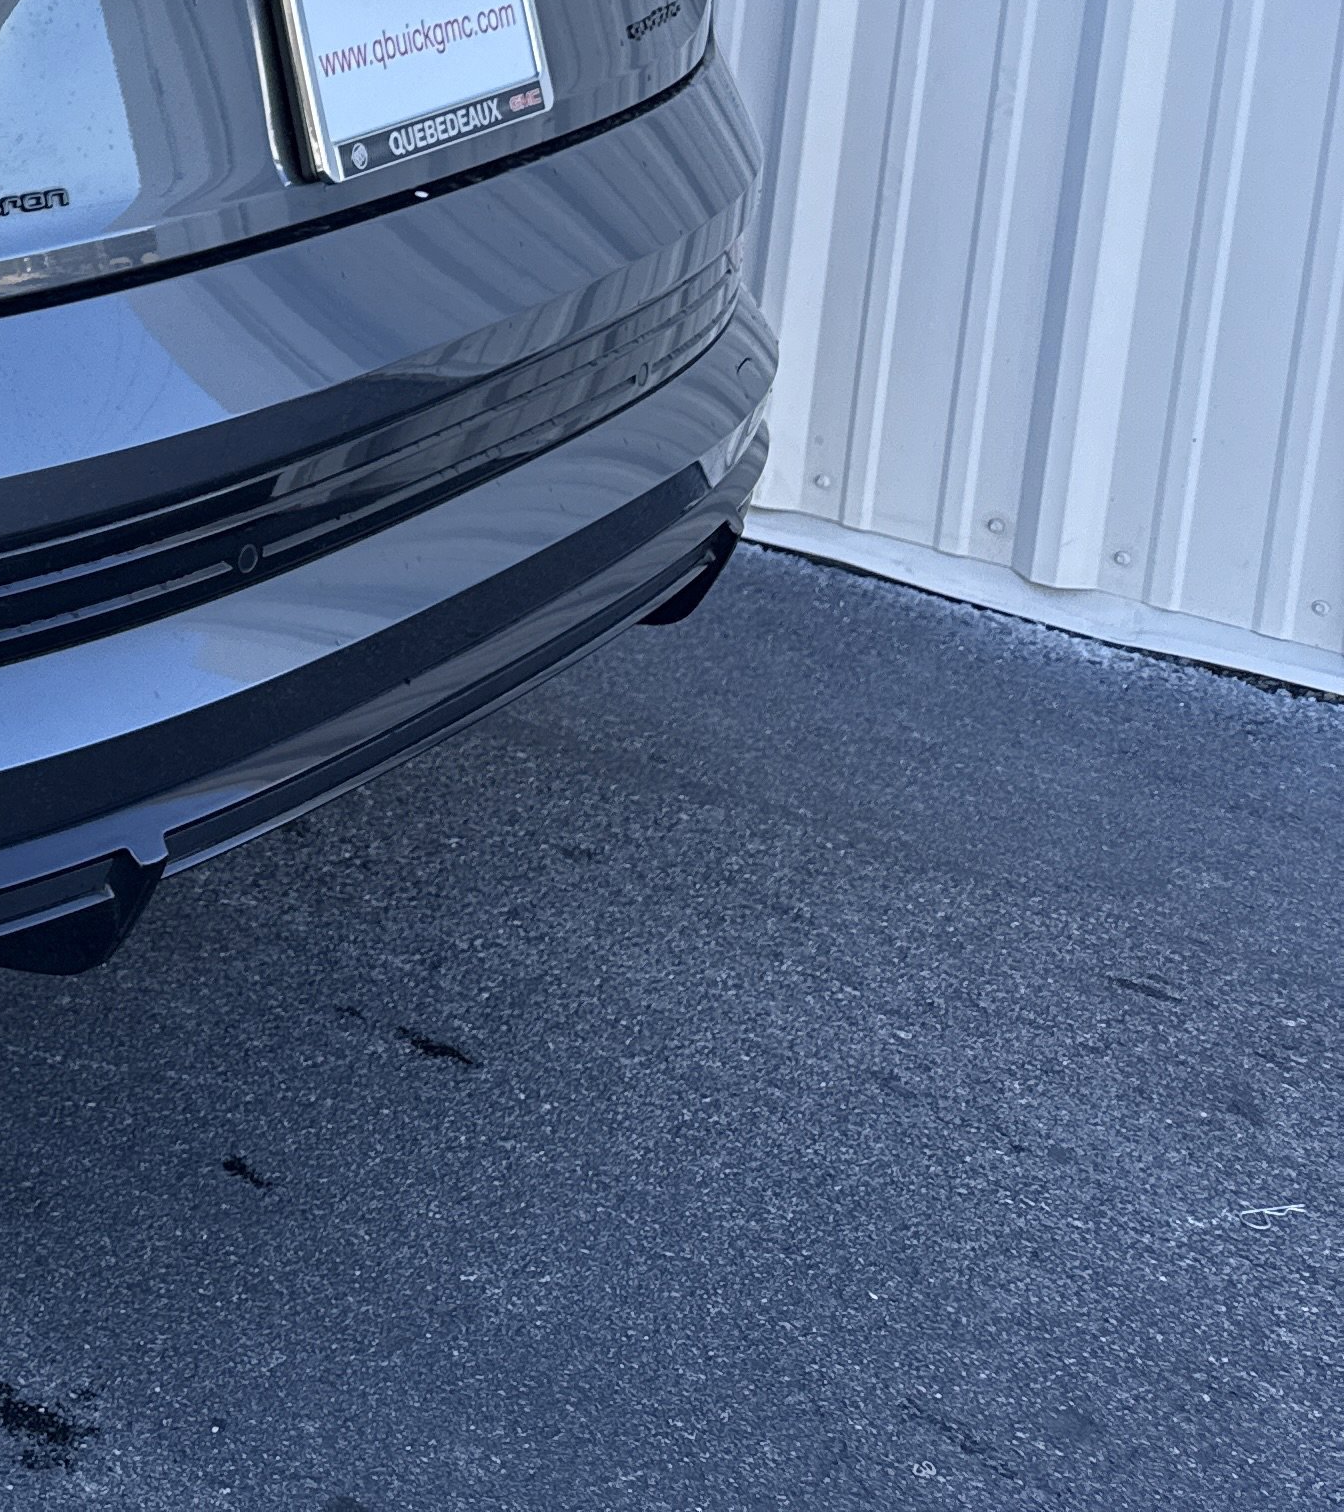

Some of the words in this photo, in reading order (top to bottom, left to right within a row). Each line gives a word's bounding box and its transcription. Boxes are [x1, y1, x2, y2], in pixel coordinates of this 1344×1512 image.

[318, 3, 517, 78] www.qbuickgmc.com
[388, 98, 503, 157] QUEBEDEAUX
[509, 89, 542, 112] GMC
